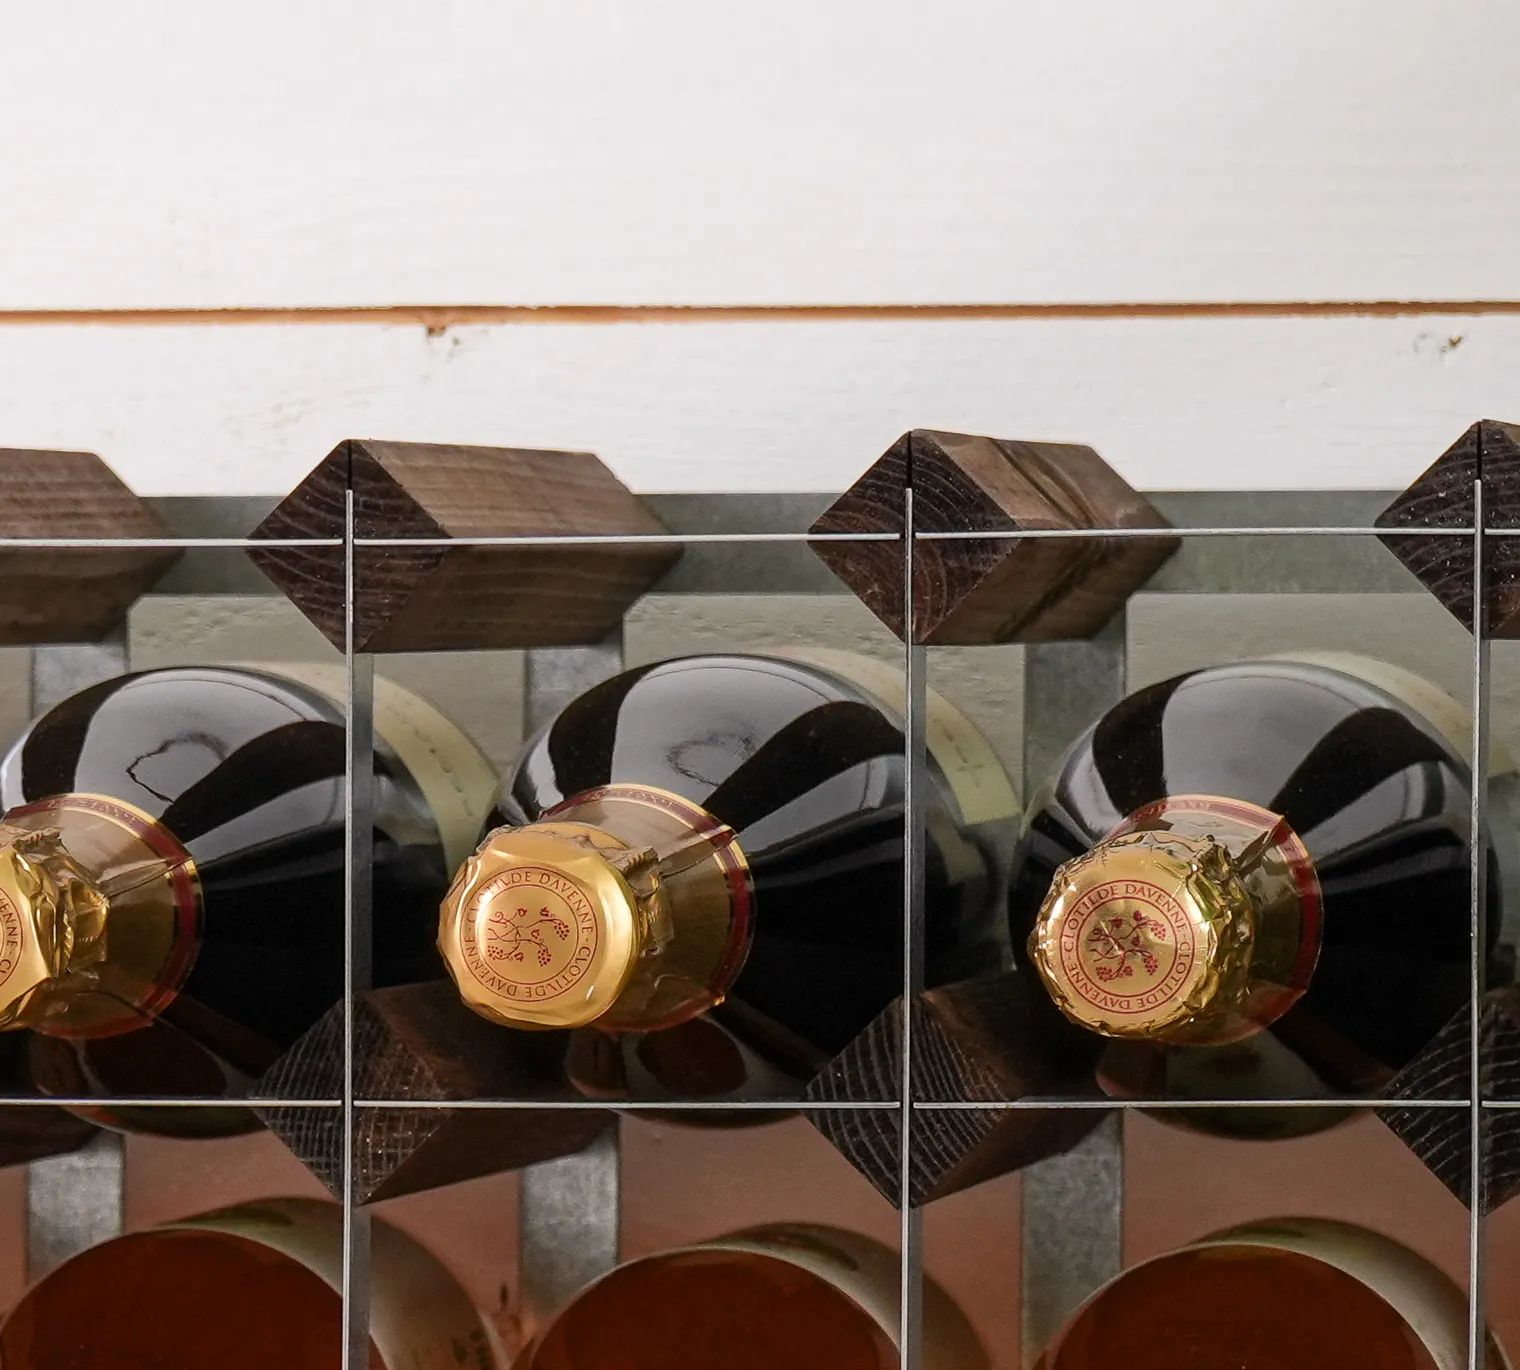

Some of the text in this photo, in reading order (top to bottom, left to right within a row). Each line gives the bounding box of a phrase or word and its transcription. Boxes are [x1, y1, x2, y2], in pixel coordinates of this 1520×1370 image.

[537, 871, 594, 934] DAVENNE
[1063, 882, 1189, 953] CLOTILDE DAVENNE
[463, 935, 592, 998] CLOTILDE DAVENNE
[1066, 940, 1190, 1010] CLOTILDE DAVENNE
